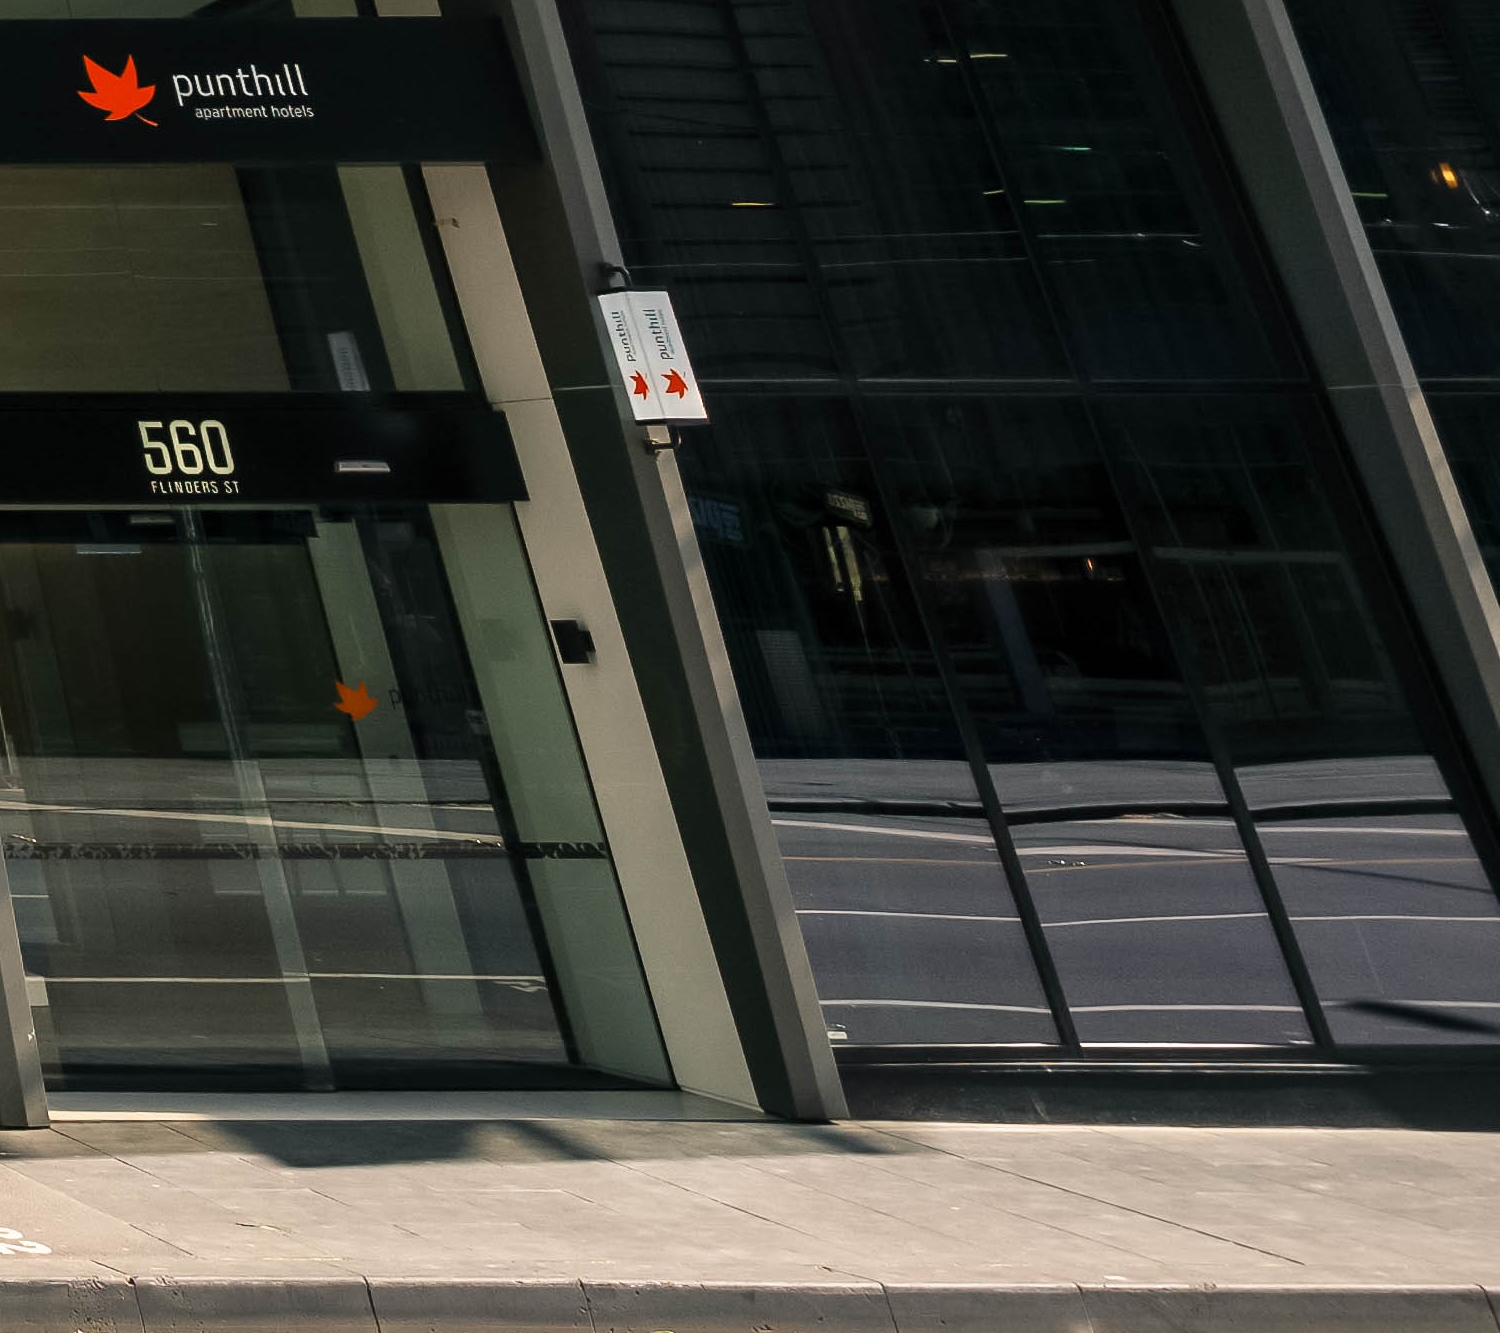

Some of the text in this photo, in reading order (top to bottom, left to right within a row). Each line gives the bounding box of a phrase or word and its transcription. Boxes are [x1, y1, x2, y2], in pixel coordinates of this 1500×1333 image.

[172, 63, 308, 107] punthill
[195, 104, 314, 120] apartment hotels
[612, 311, 637, 362] punthill
[642, 308, 674, 360] punthill
[138, 419, 235, 475] 560
[150, 480, 240, 494] FLINDERS ST
